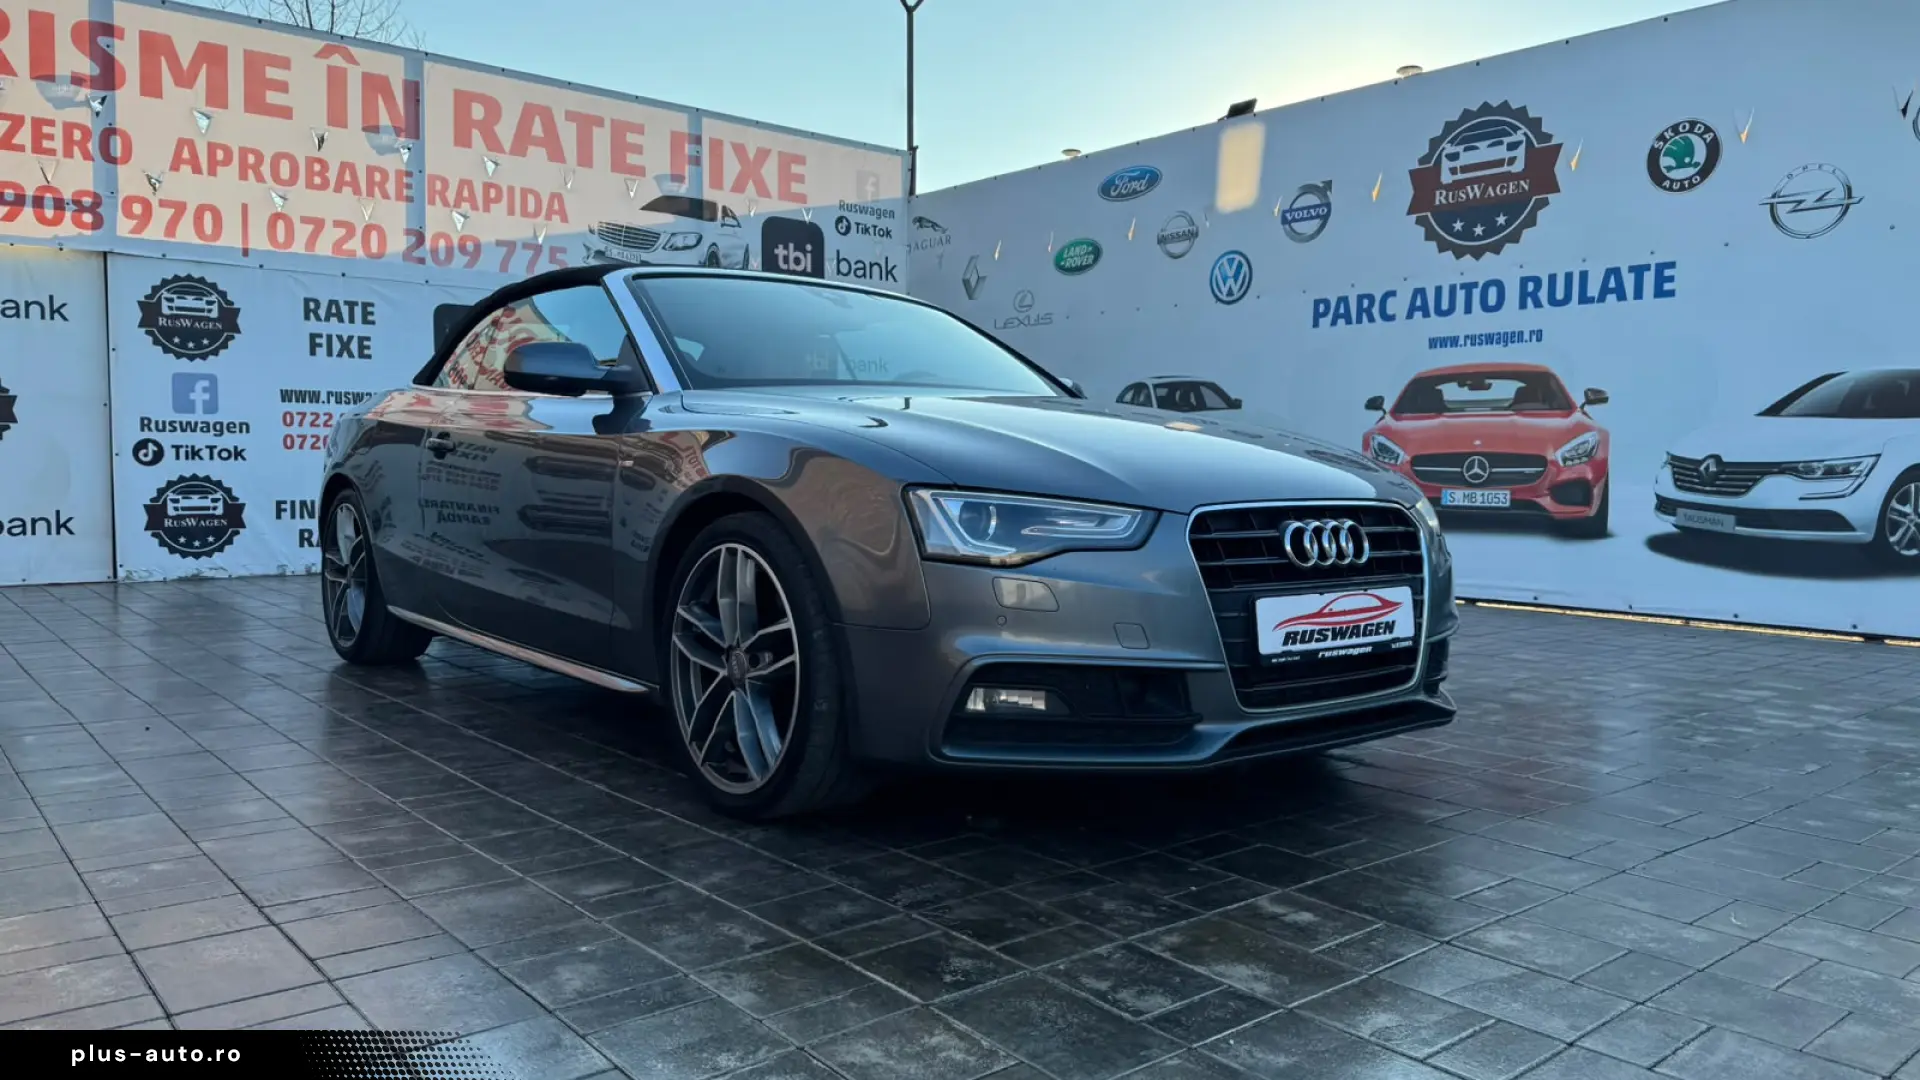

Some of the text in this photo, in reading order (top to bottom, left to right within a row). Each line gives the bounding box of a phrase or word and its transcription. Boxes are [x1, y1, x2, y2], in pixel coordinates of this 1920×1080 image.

[313, 43, 420, 141] ÎN
[453, 89, 646, 177] RATE
[669, 130, 808, 205] FIXE
[1654, 121, 1715, 150] SKODA
[0, 112, 569, 224] ZERO APROBARE RAPIDA
[1109, 170, 1151, 196] Ford
[1662, 175, 1701, 190] AUTO
[838, 200, 895, 220] Ruswagen
[1285, 206, 1327, 220] VOLVO
[0, 180, 104, 230] 908
[121, 195, 223, 242] 970
[266, 212, 387, 260] 0720
[402, 229, 482, 269] 209
[495, 239, 569, 276] 775
[855, 222, 893, 239] TikTok
[1161, 227, 1195, 244] NISSAN
[1063, 245, 1087, 258] LAND
[1064, 255, 1095, 268] ROVER
[774, 243, 898, 283] tbi bank
[1312, 261, 1677, 328] PARC AUTO RULATE
[303, 297, 376, 325] RATE
[994, 313, 1054, 330] LEXUS
[309, 333, 372, 360] FIXE
[1428, 328, 1543, 350] www.ruswagen.ro
[280, 389, 378, 405] www.rusw
[139, 416, 250, 437] Ruswagen
[282, 411, 334, 428] 0722
[172, 444, 247, 462] TikTok
[0, 510, 76, 537] ank
[1282, 620, 1396, 647] RUSWAGEN
[1318, 646, 1373, 658] ruswagen
